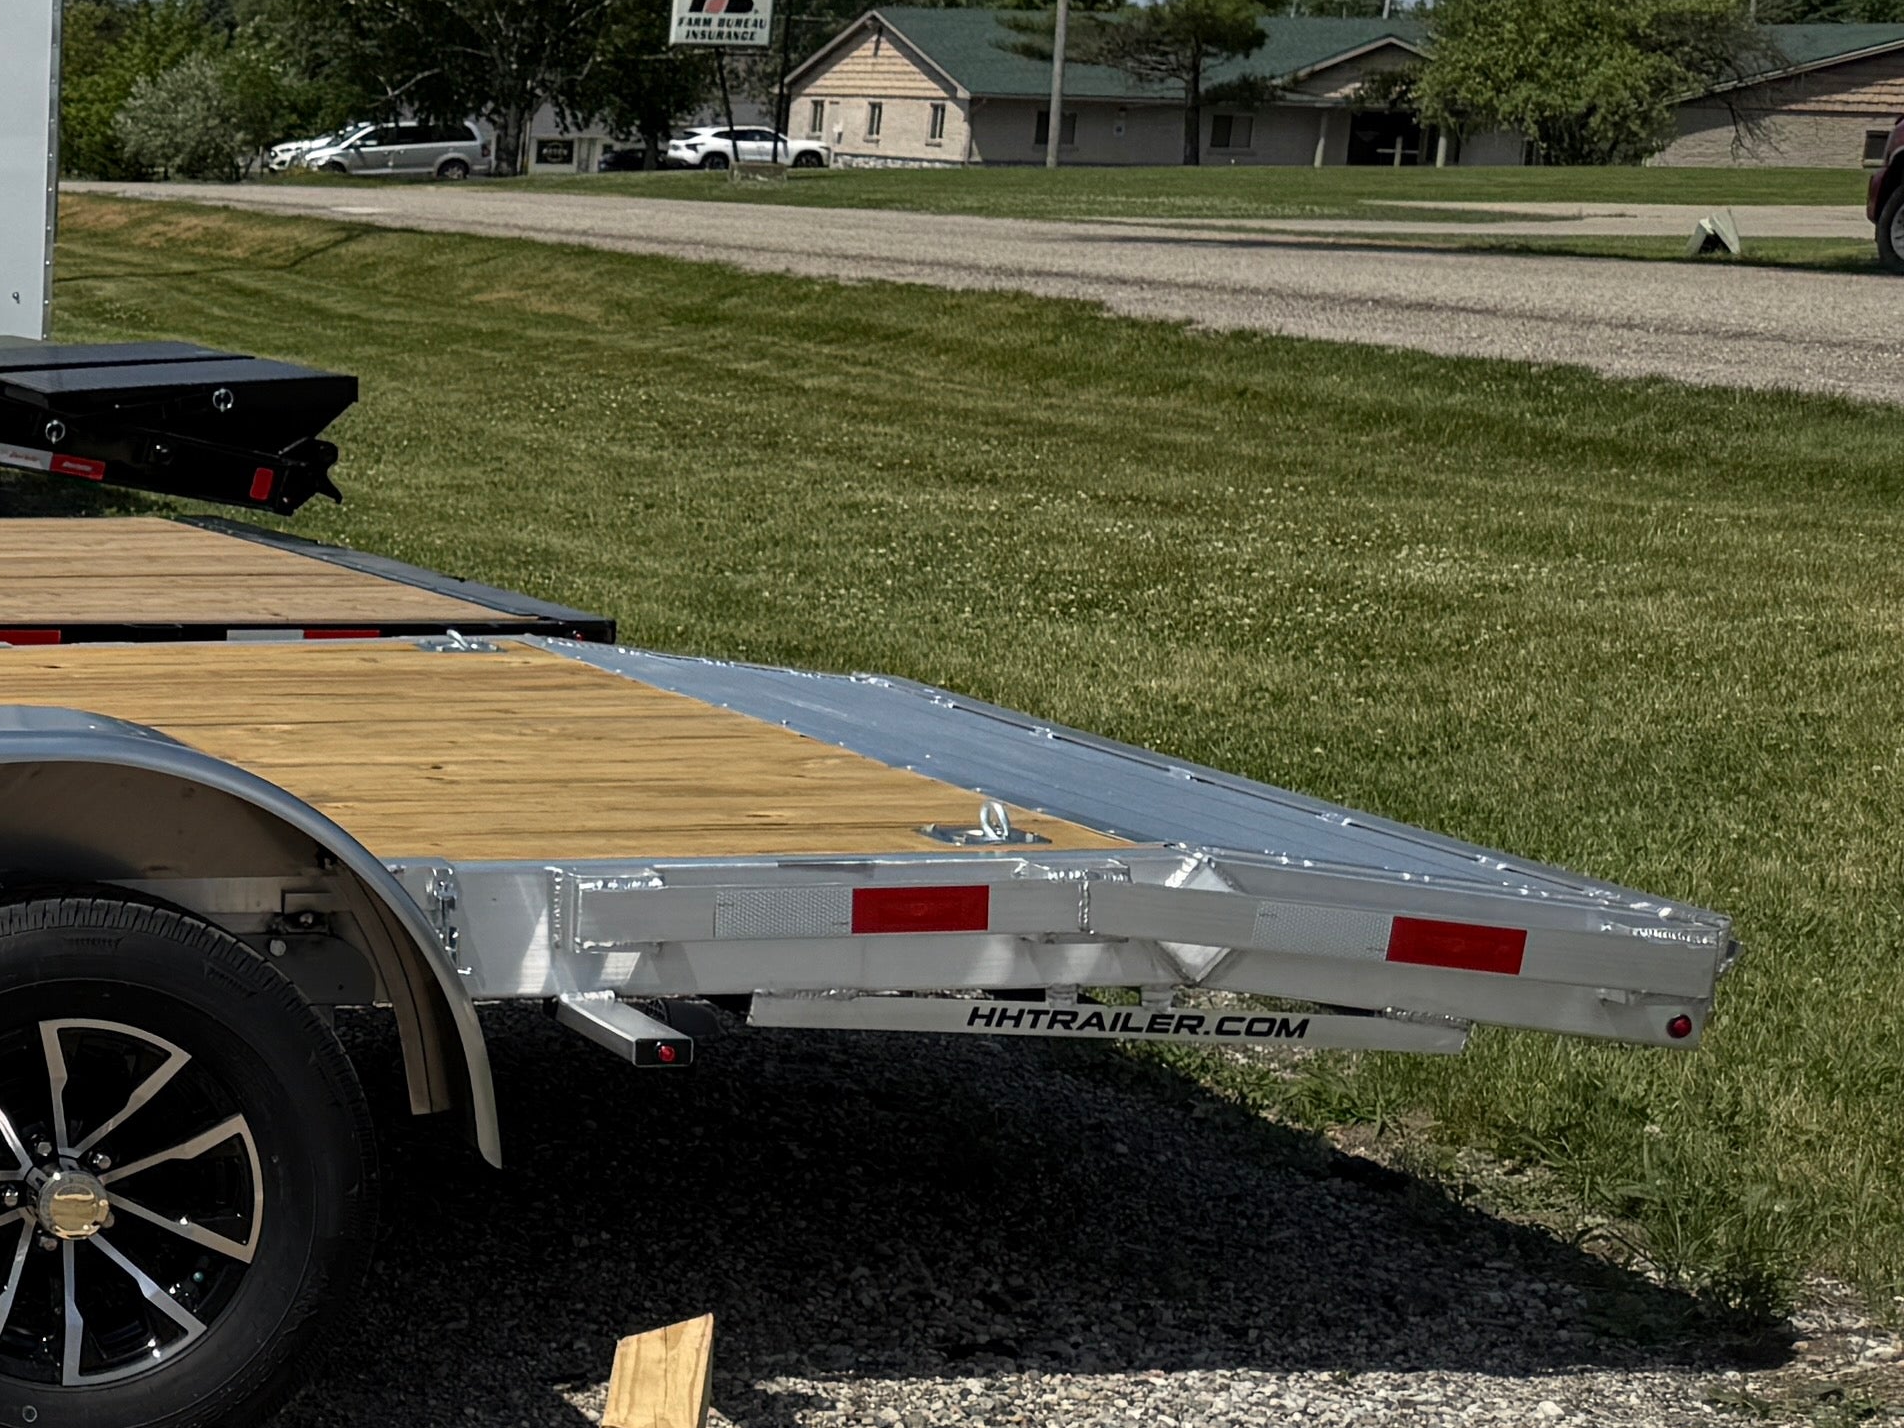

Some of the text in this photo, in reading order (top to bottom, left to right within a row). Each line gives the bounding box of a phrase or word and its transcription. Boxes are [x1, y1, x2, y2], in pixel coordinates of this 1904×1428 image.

[677, 17, 766, 29] FARM BUREAU
[685, 30, 756, 41] INSURANCE
[967, 1006, 1311, 1039] HHTRAILER.COM
